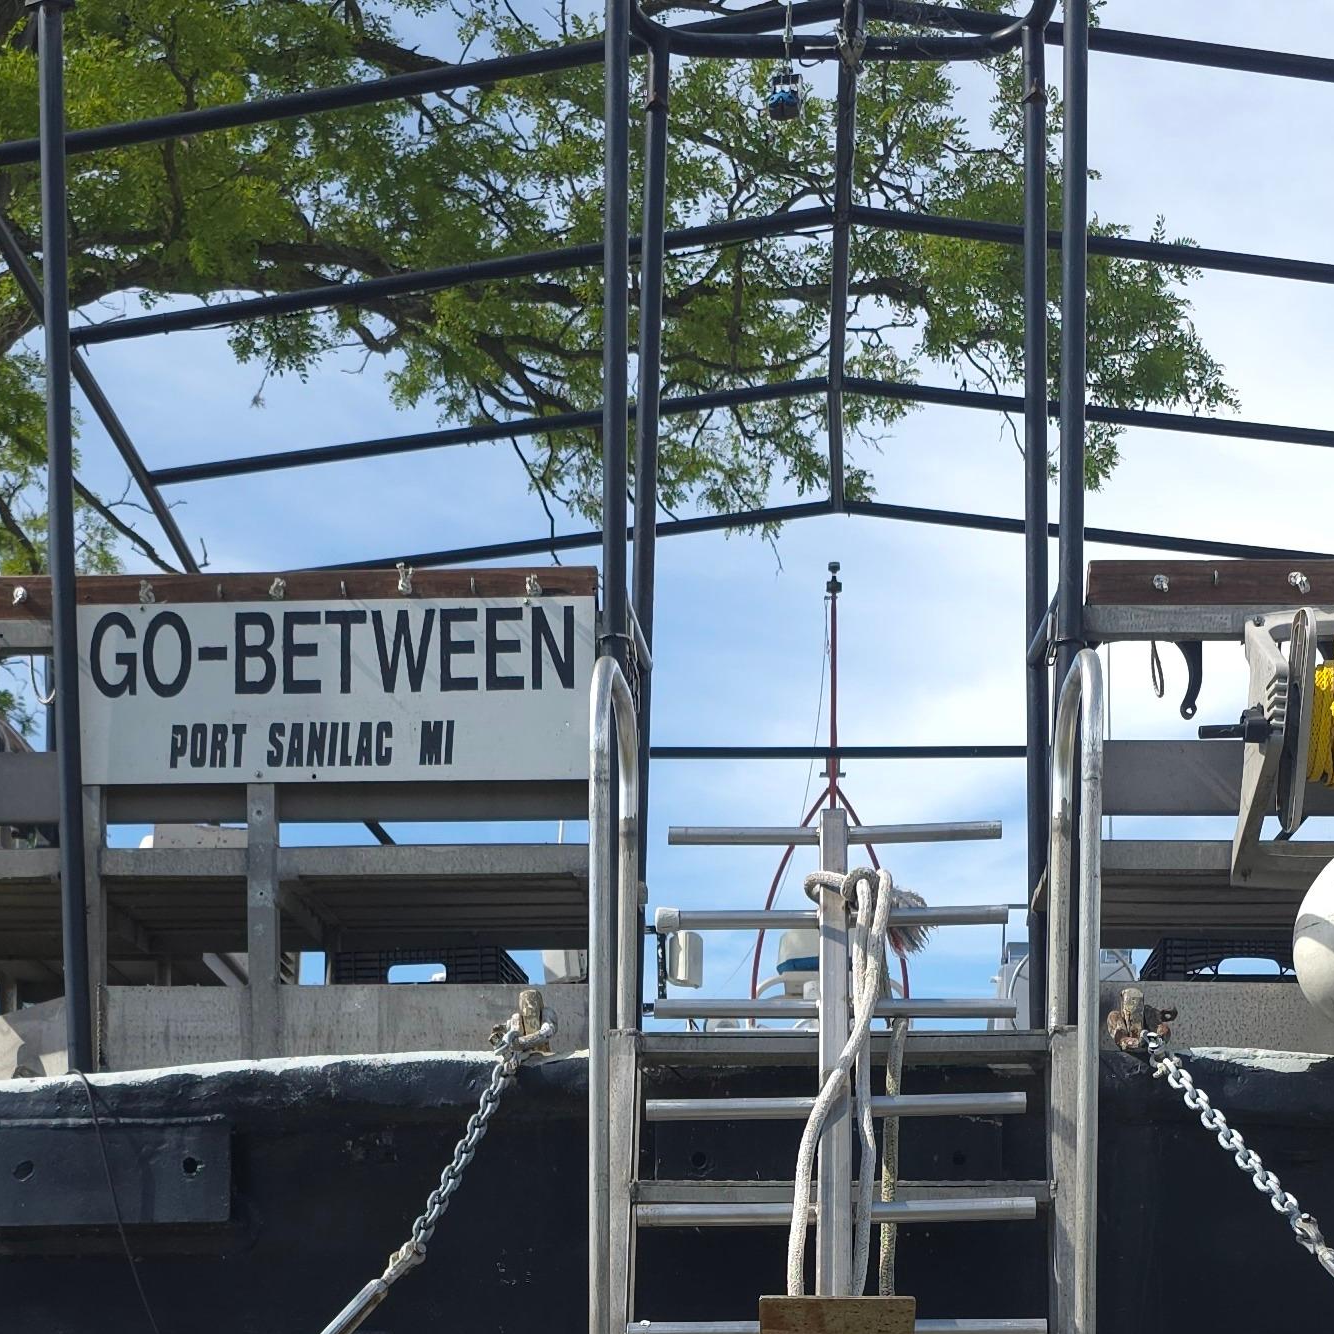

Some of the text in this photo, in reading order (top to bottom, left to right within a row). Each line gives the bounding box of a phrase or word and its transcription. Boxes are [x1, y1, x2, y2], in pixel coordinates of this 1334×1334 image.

[89, 605, 575, 699] GO-BETWEEN
[169, 719, 455, 769] PORT SANILAC MI
